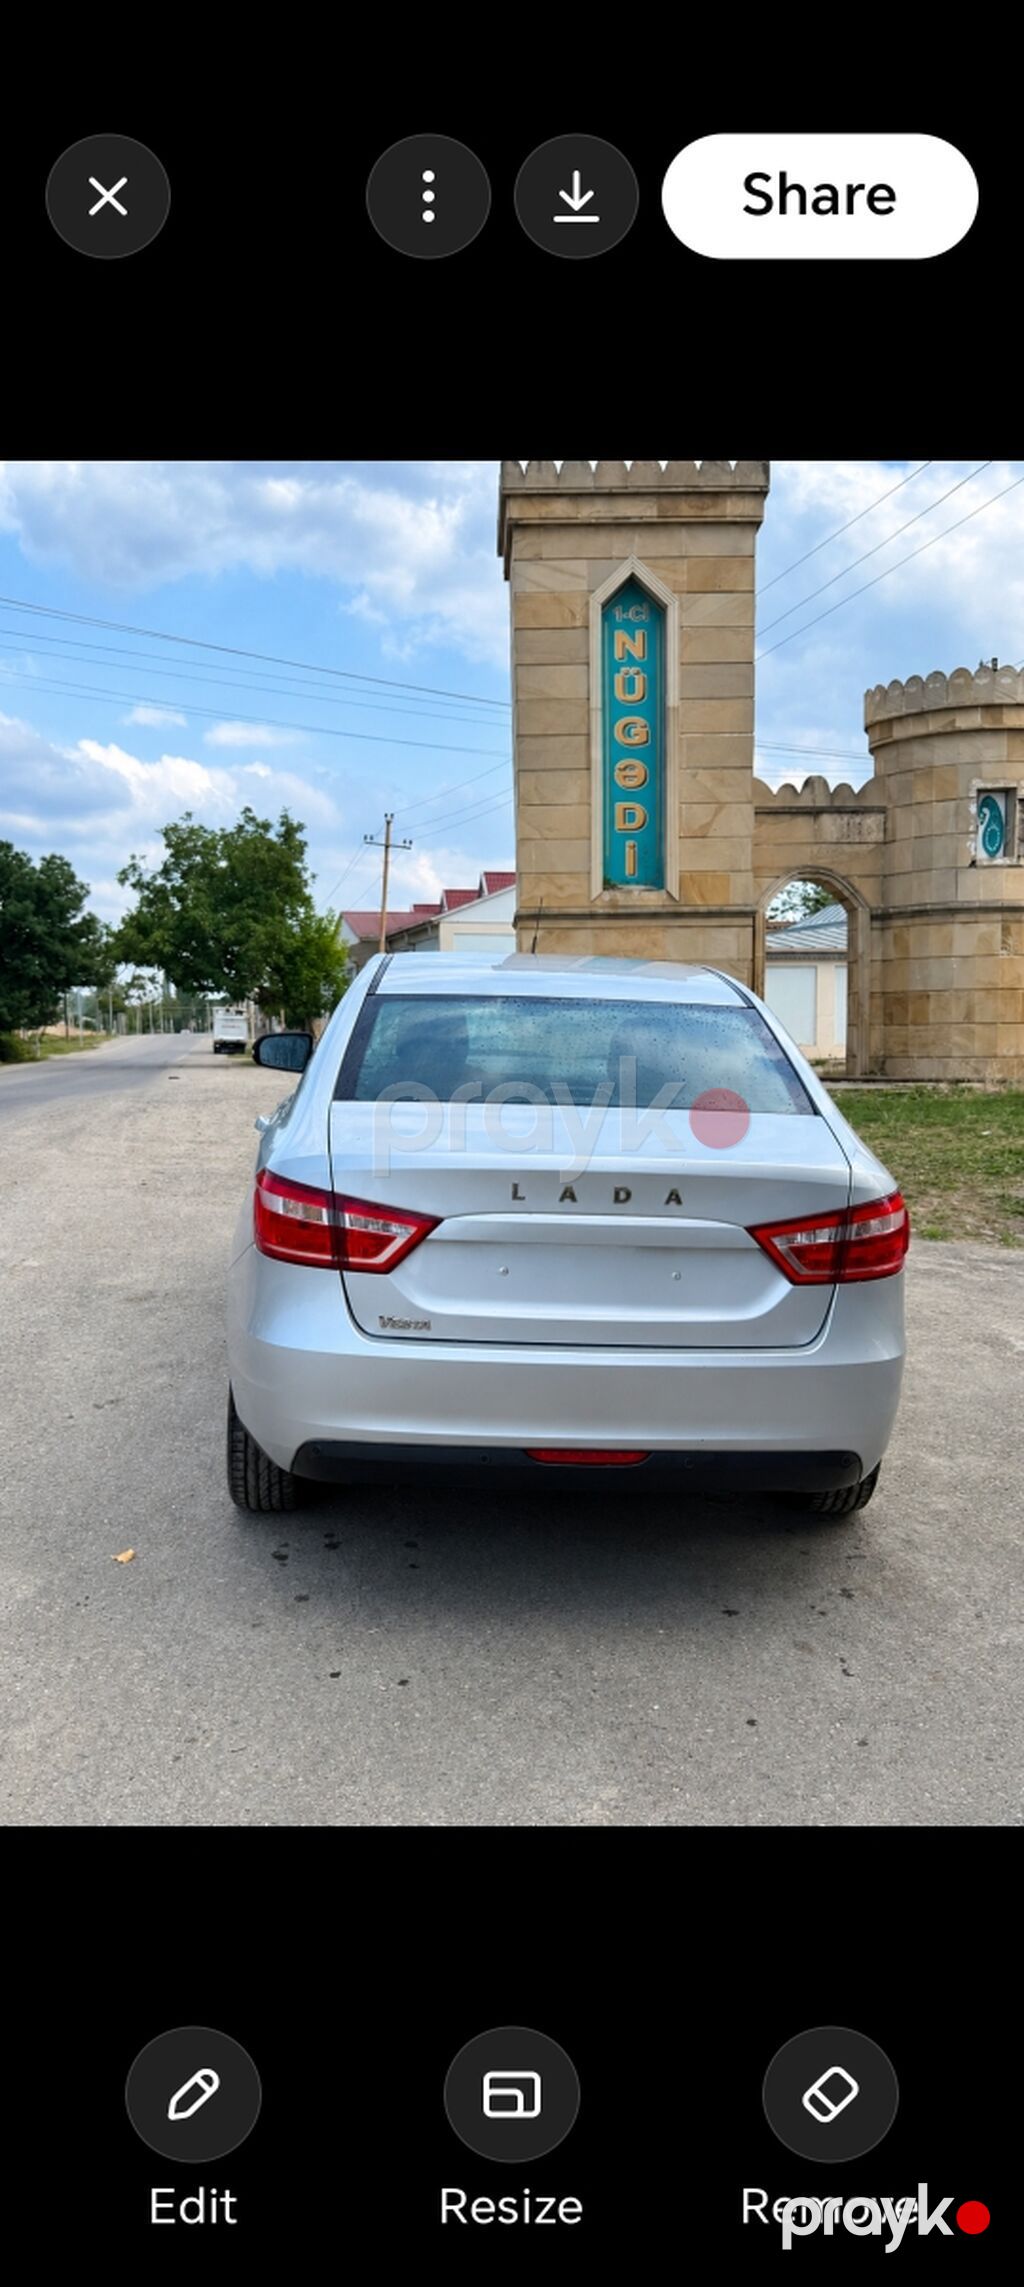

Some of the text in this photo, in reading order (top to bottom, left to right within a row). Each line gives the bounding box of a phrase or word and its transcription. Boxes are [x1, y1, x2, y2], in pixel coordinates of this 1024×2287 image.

[743, 171, 896, 216] Share
[511, 1183, 683, 1206] LADA
[150, 2186, 238, 2225] Edit
[441, 2186, 583, 2225] Resize
